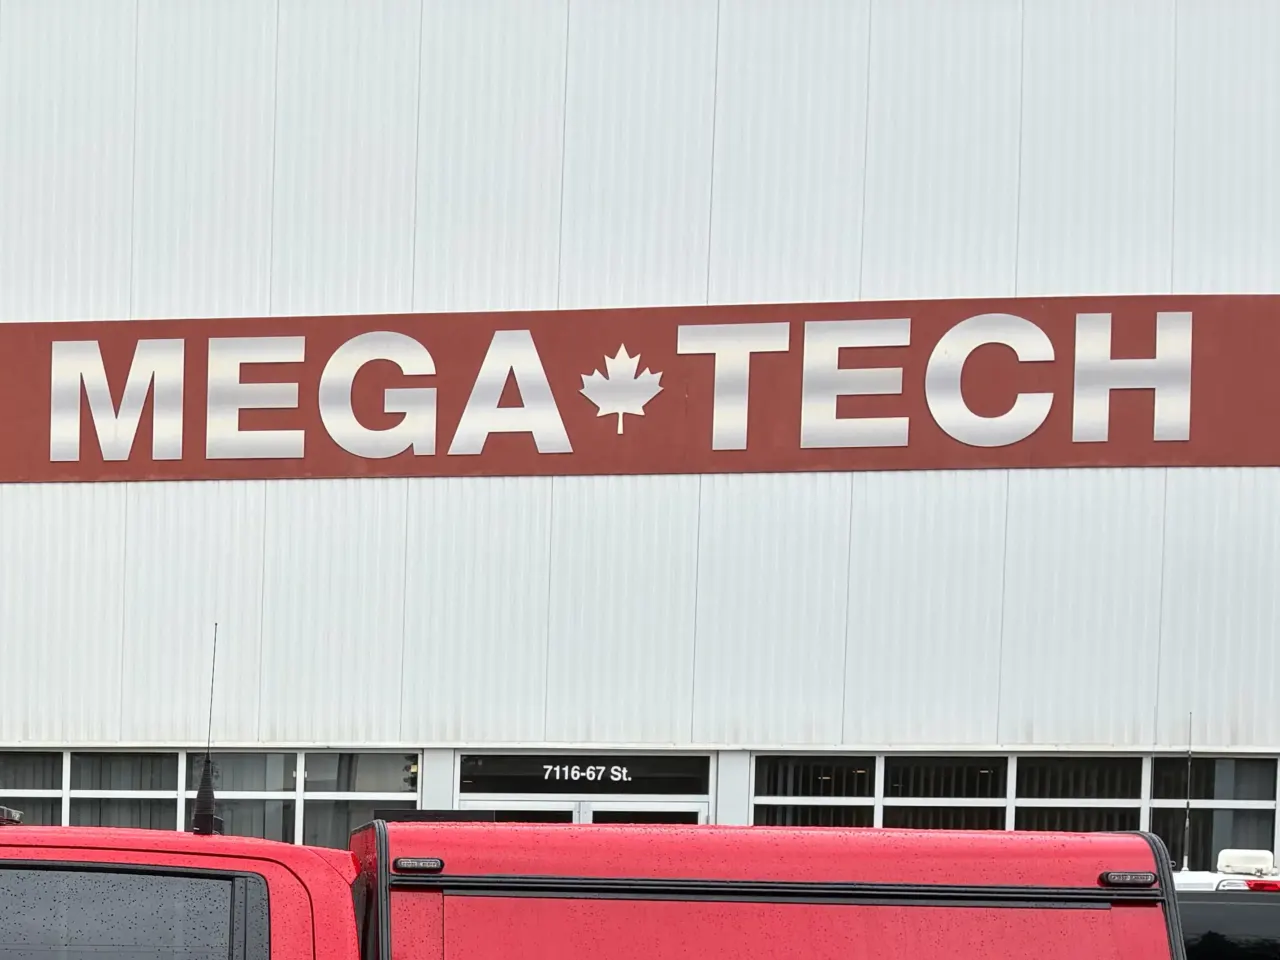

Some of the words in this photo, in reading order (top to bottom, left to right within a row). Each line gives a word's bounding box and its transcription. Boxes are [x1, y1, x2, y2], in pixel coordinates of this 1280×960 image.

[50, 329, 574, 462] MEGA
[676, 311, 1193, 451] TECH
[543, 764, 606, 781] 7116-67
[610, 765, 632, 782] St.
